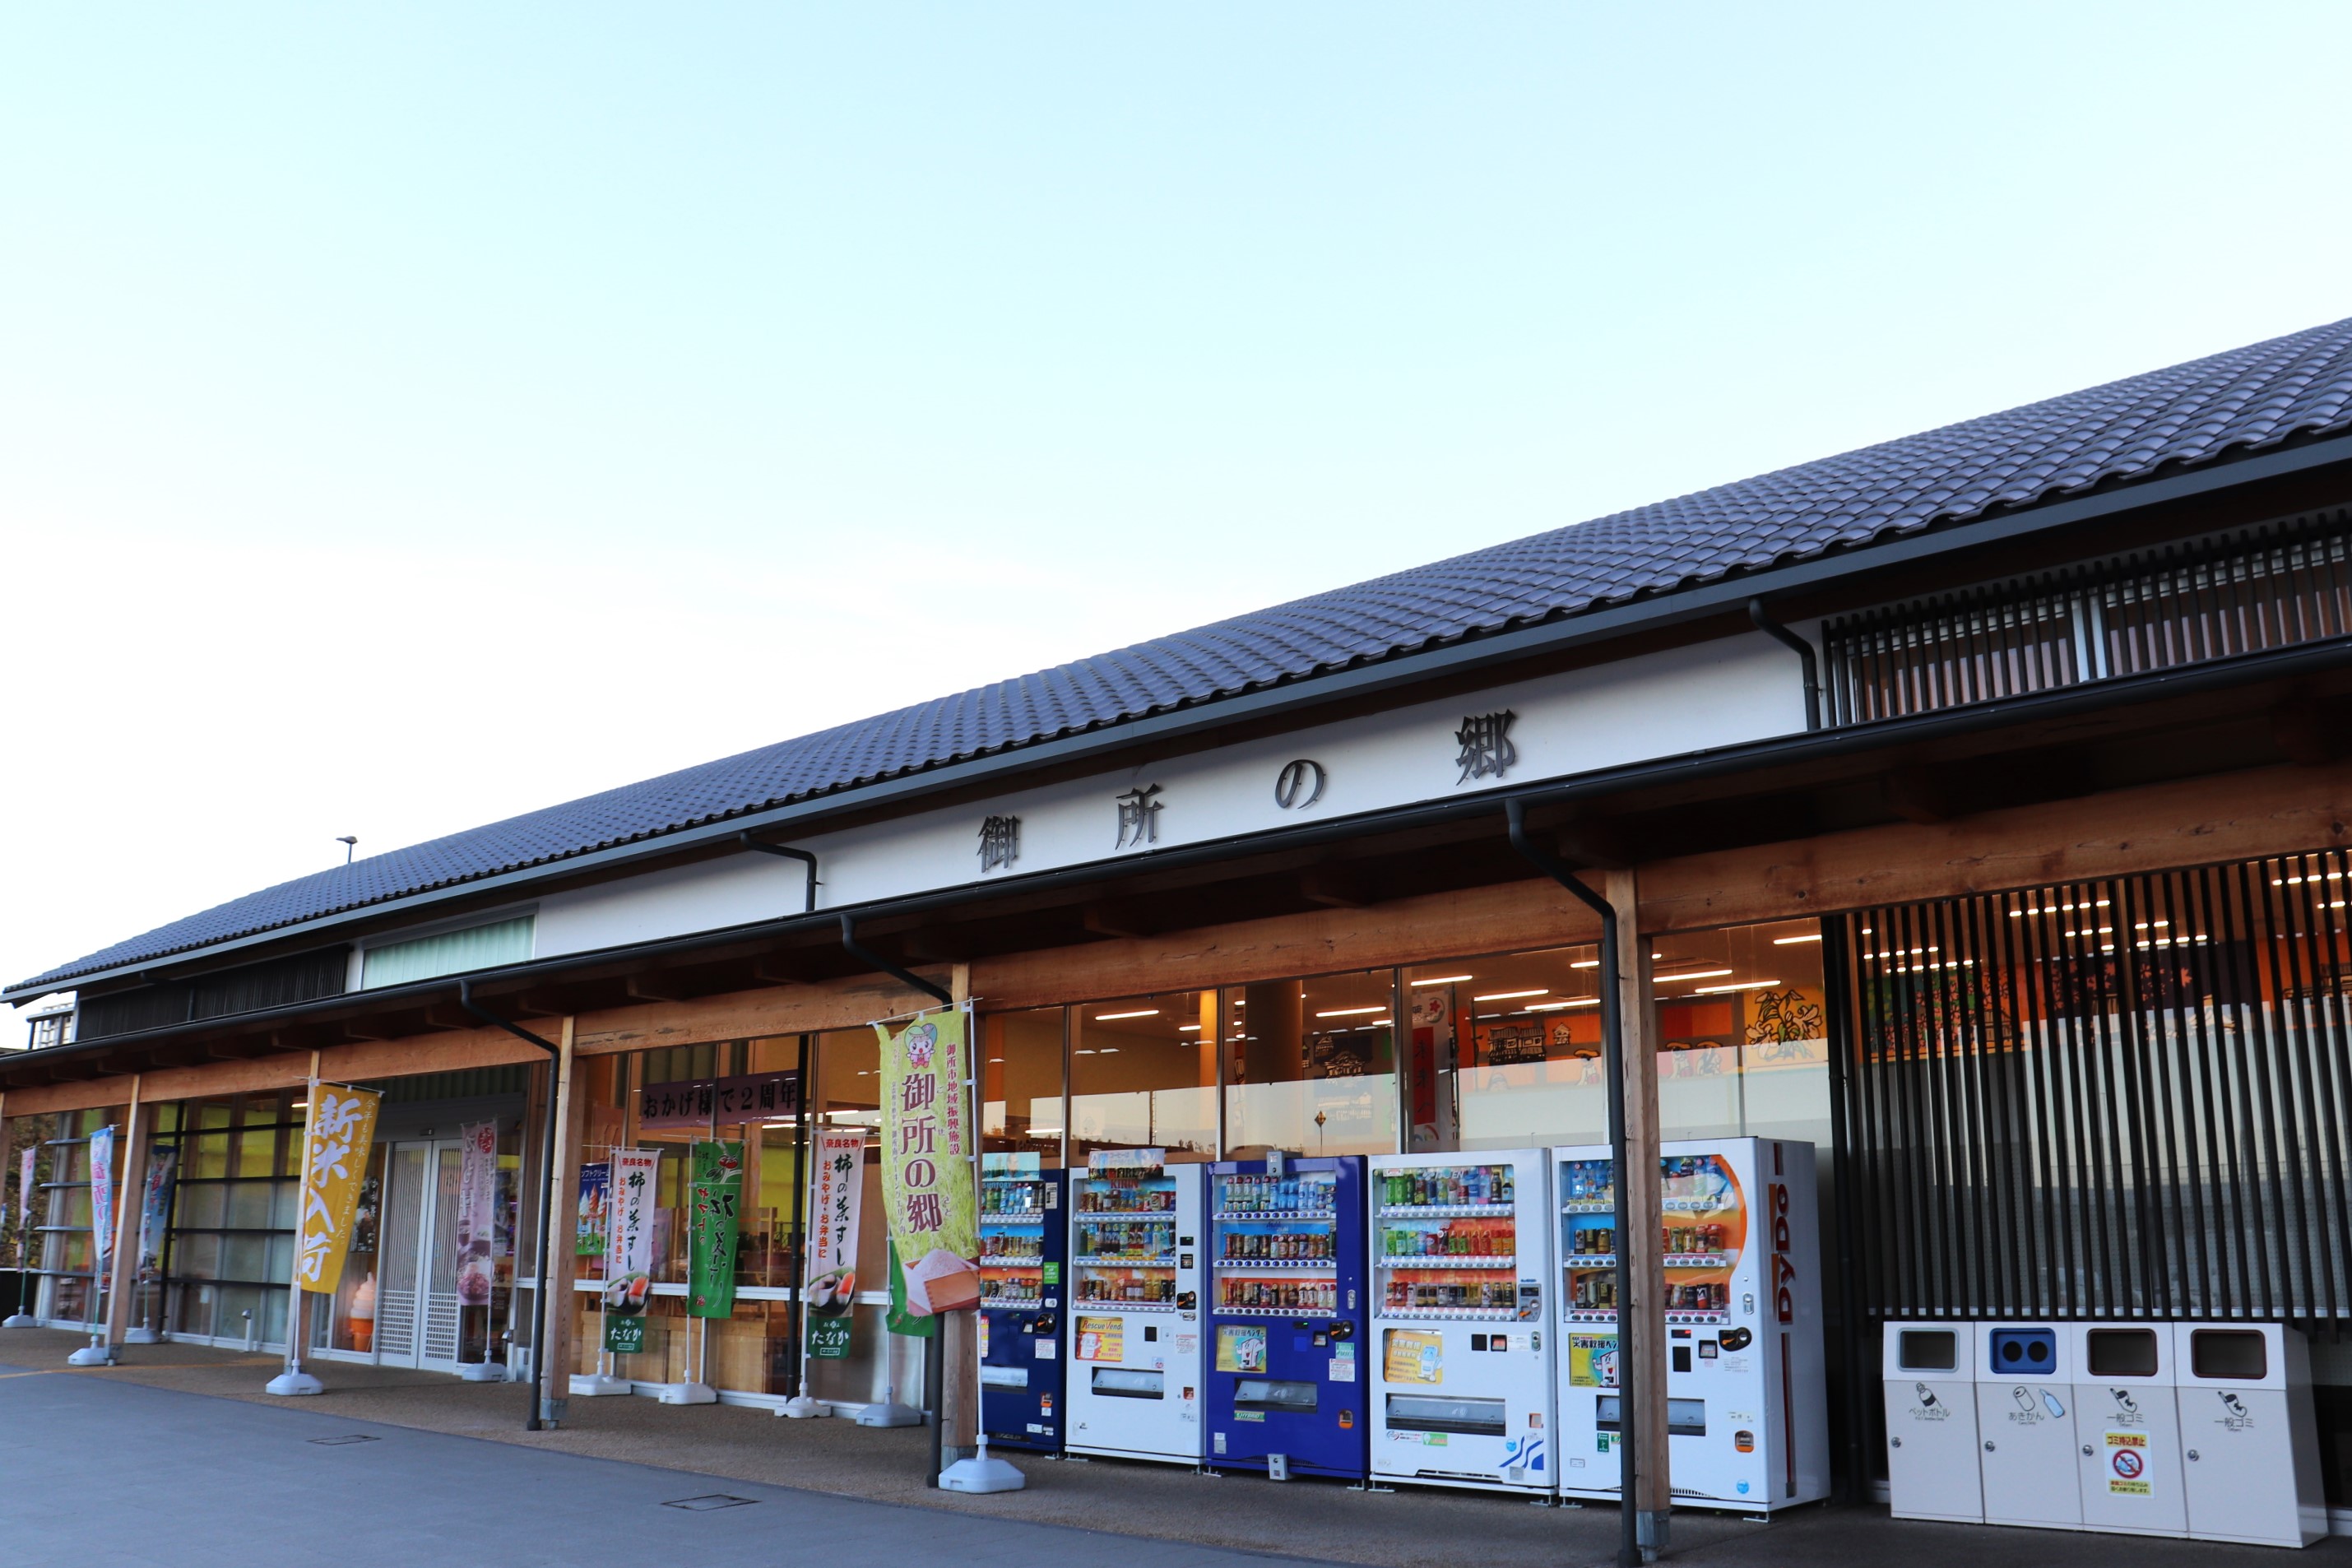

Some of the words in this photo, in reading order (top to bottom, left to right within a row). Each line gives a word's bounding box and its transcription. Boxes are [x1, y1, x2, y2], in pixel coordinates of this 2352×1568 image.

[977, 709, 1517, 874] 御所の郷
[947, 1044, 960, 1155] 御所市地域振興施設
[826, 1139, 860, 1148] 奈良名物
[900, 1073, 943, 1233] 御所の郷
[622, 1157, 652, 1167] 奈良名物
[302, 1093, 364, 1283] 新米入荷
[834, 1153, 853, 1267] 柿の葉すし
[627, 1171, 645, 1271] 柿の葉すし
[1083, 1320, 1106, 1330] Rescue
[1106, 1321, 1123, 1330] Vend
[610, 1327, 642, 1342] たなか
[812, 1329, 849, 1346] たなか
[1909, 1408, 1950, 1417] ペットボトル
[2008, 1412, 2045, 1421] あきかん
[2107, 1413, 2144, 1423] 一般ゴミ
[2215, 1417, 2255, 1428] 一般ゴミ
[2108, 1436, 2146, 1447] ゴミ持込禁止
